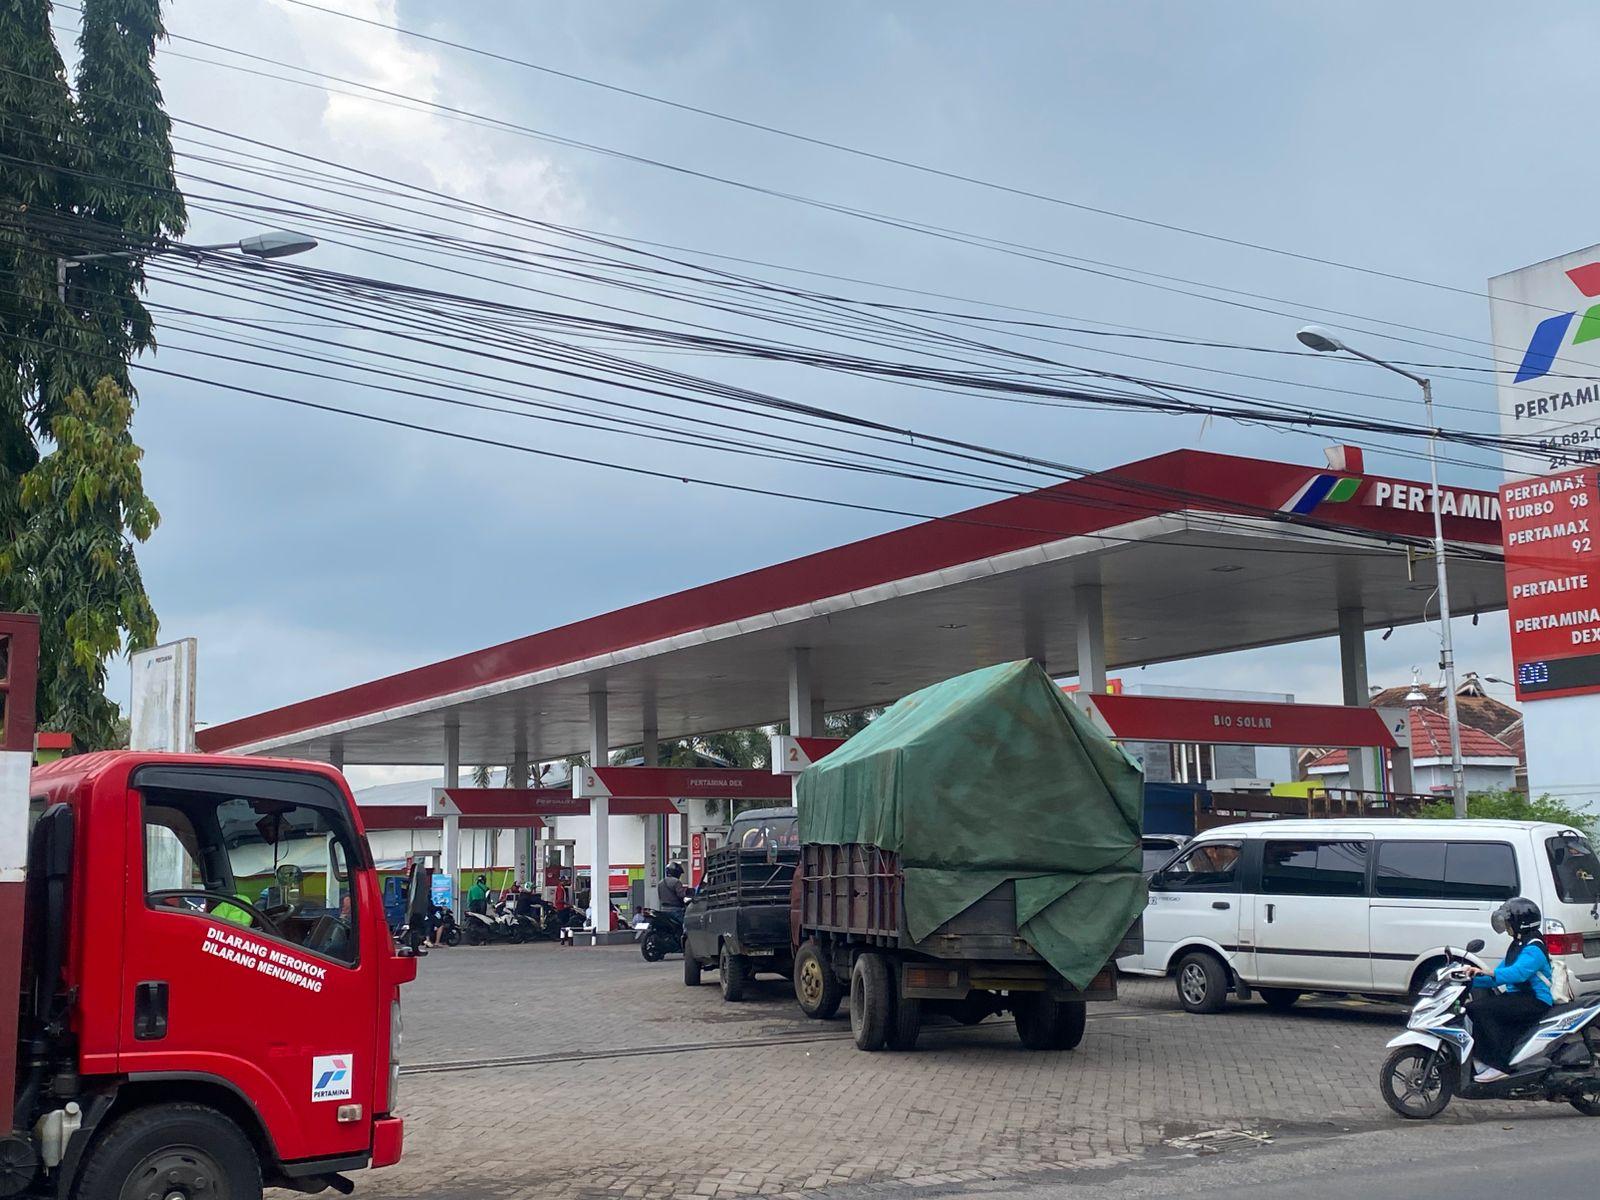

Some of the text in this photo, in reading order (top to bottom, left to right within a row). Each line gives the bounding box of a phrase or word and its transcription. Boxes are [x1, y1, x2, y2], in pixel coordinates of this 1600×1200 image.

[1514, 384, 1600, 420] PERTAMI
[1505, 474, 1586, 503] PERTAMAX
[1507, 492, 1588, 520] TURBO 98
[1508, 518, 1590, 546] PERTAMAX
[1572, 537, 1592, 553] 92
[1512, 574, 1589, 599] PERTALITE
[1515, 607, 1600, 633] PERTAMINA
[1571, 628, 1600, 645] DEX
[1213, 714, 1272, 729] BIO SOLAR
[789, 748, 799, 762] 2
[586, 776, 595, 788] 3
[438, 796, 446, 808] 4
[206, 927, 328, 980] DILARANG MEROKOK
[201, 941, 323, 993] DILARANG MENUMPANG
[313, 1088, 350, 1099] PERTAMINA
